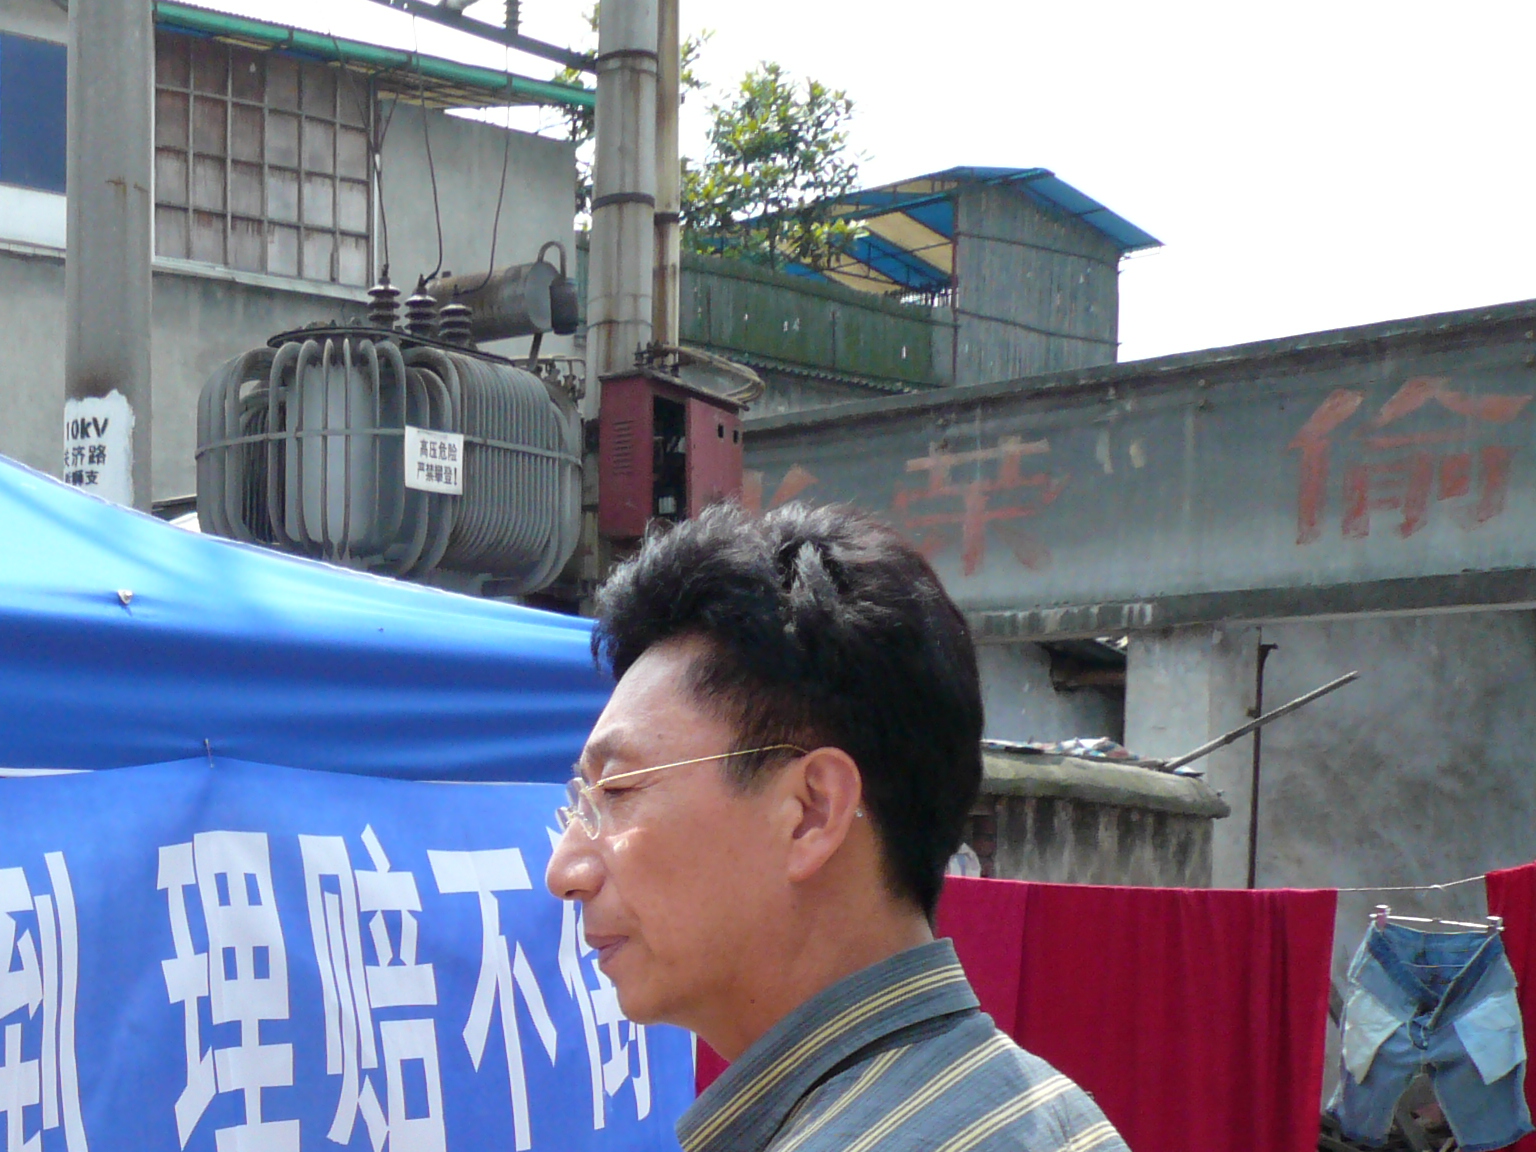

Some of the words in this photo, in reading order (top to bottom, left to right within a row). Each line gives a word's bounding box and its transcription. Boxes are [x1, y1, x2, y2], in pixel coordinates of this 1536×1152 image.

[66, 416, 109, 441] 10kV
[419, 438, 457, 462] 高压危险
[1286, 376, 1533, 545] 偷
